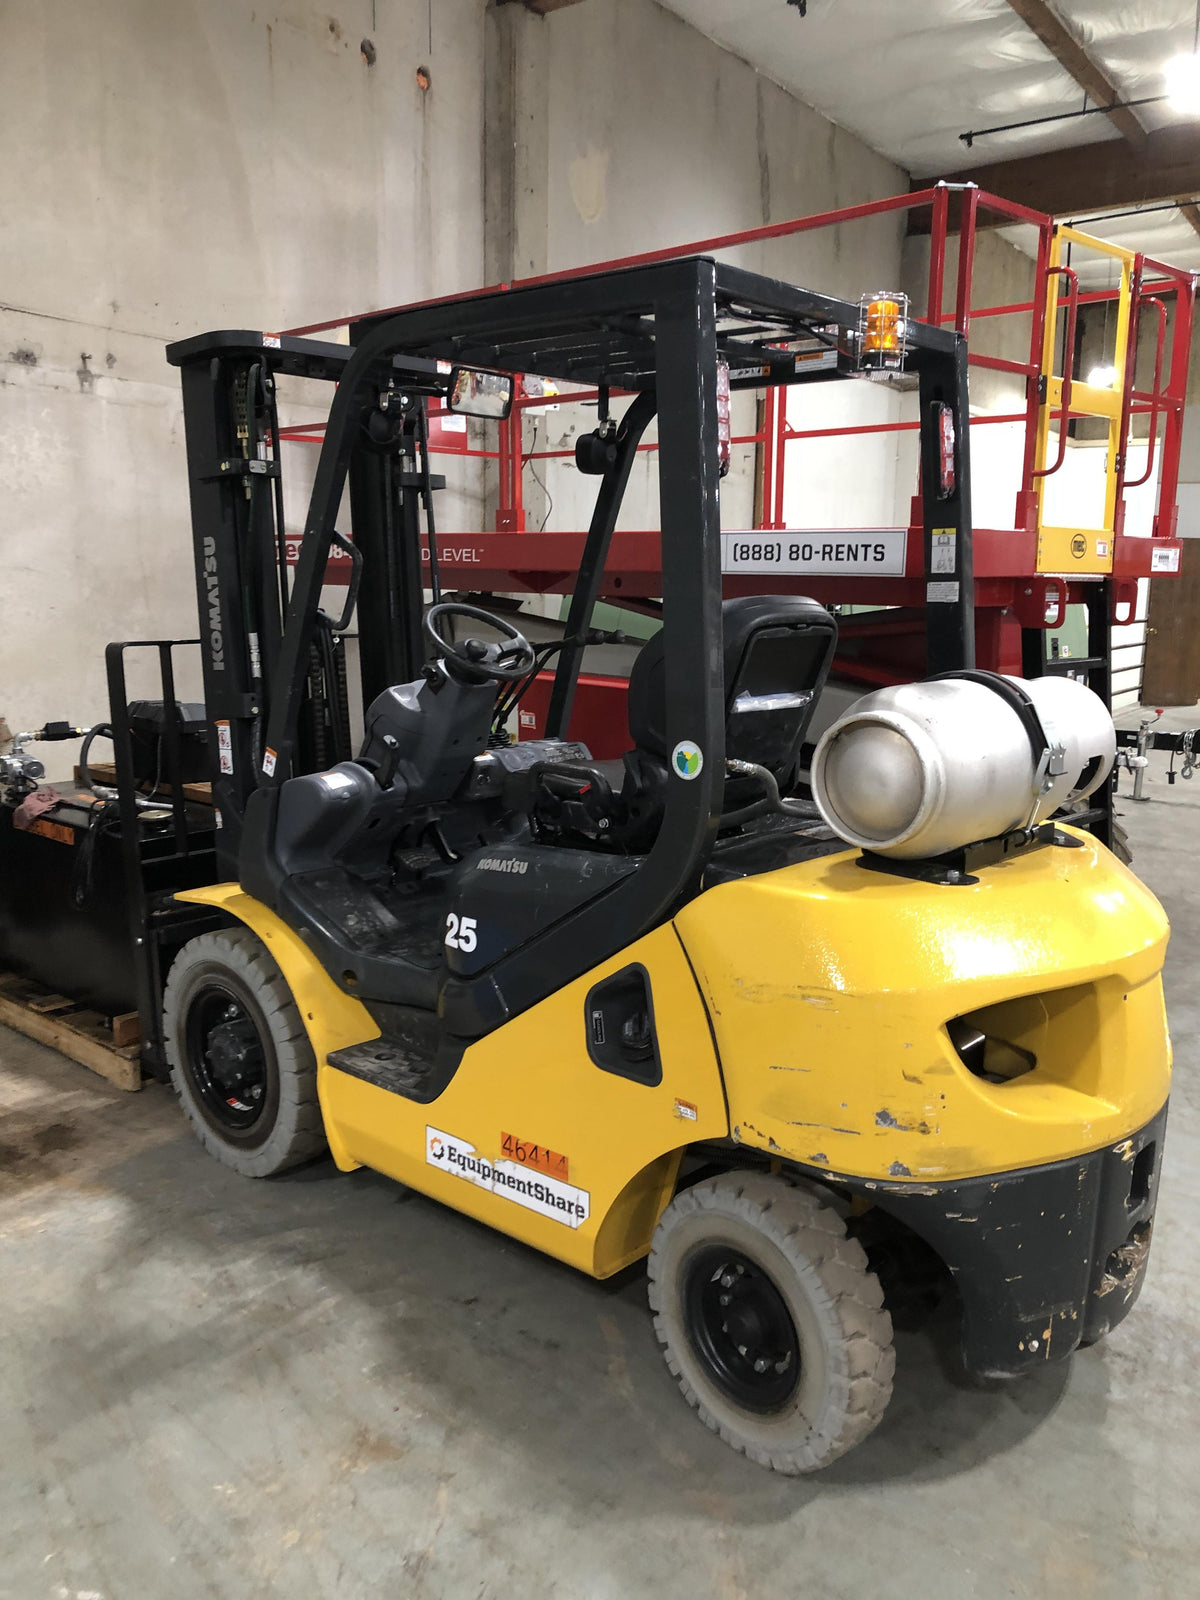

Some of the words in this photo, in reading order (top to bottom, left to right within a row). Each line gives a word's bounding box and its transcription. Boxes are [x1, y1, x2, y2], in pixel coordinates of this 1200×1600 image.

[733, 543, 781, 562] (888)
[788, 543, 886, 562] 80-RENTS
[203, 536, 225, 671] KOMATSU
[476, 858, 528, 874] KOMATSU
[445, 912, 477, 953] 25
[447, 1145, 585, 1219] EquipmentShare
